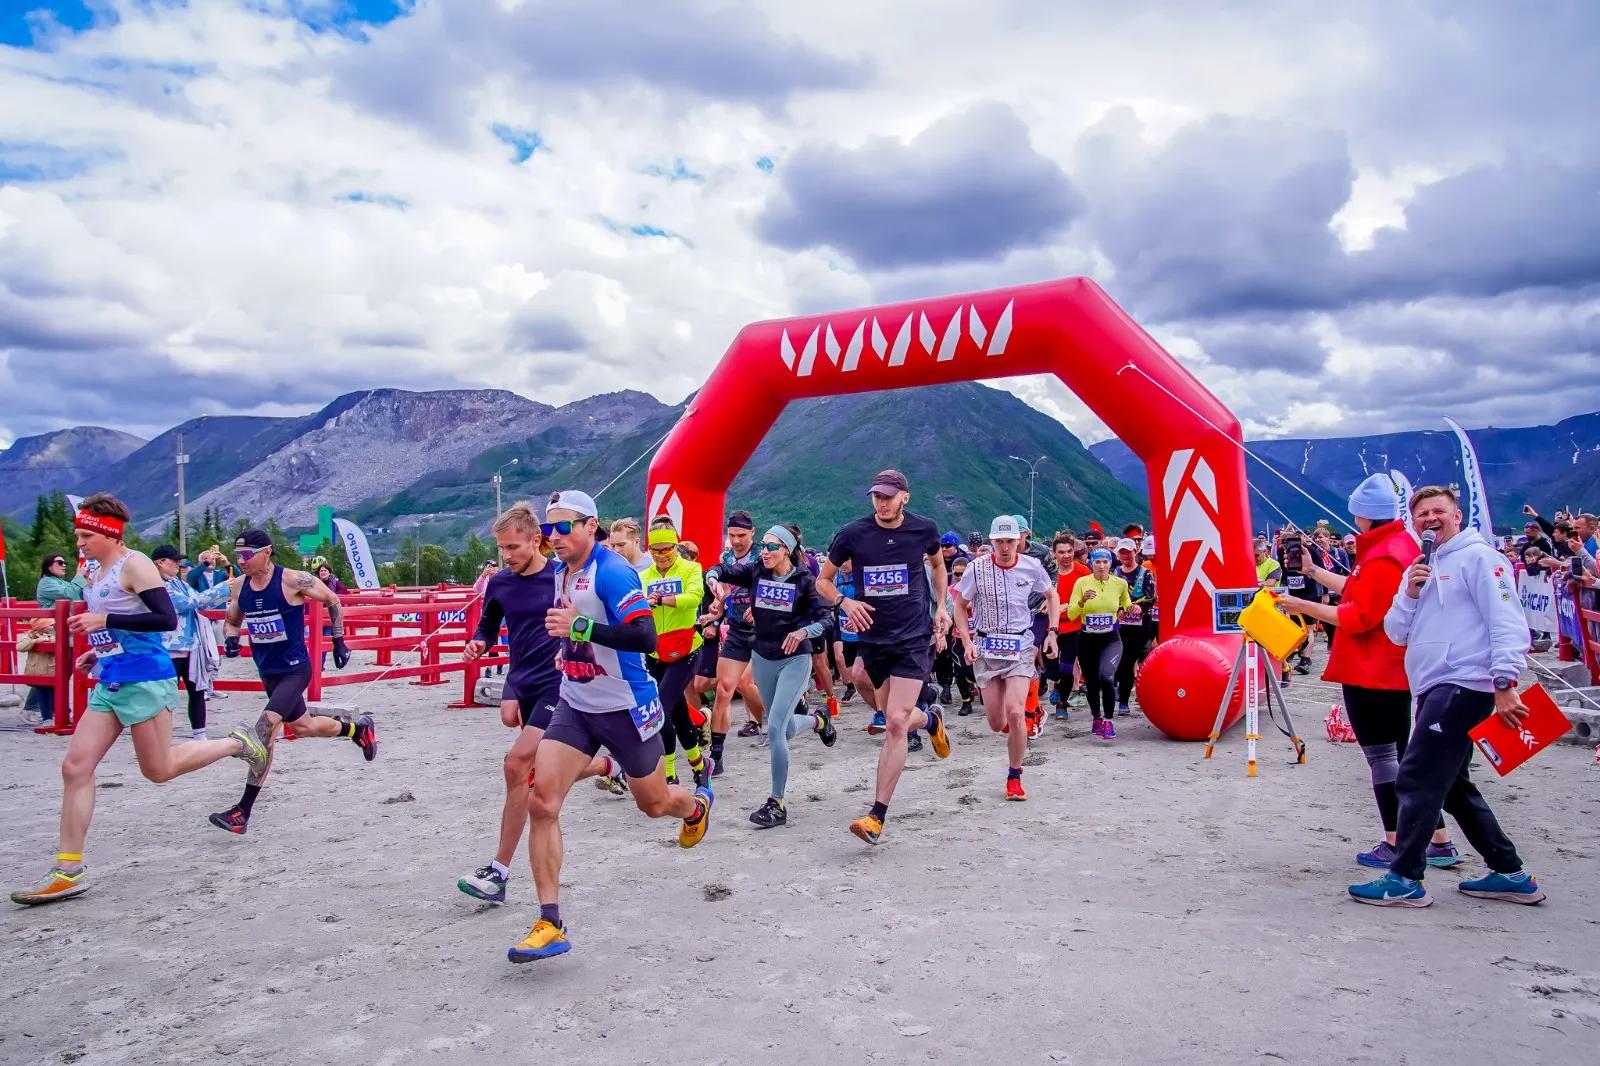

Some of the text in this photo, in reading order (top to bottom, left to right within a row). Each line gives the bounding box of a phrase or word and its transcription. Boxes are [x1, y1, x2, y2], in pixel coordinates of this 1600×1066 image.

[869, 571, 903, 585] 3456
[761, 586, 790, 601] 3435
[252, 621, 278, 634] 3011
[1088, 617, 1111, 626] 3458
[91, 630, 112, 646] 3133
[989, 639, 1016, 651] 3355
